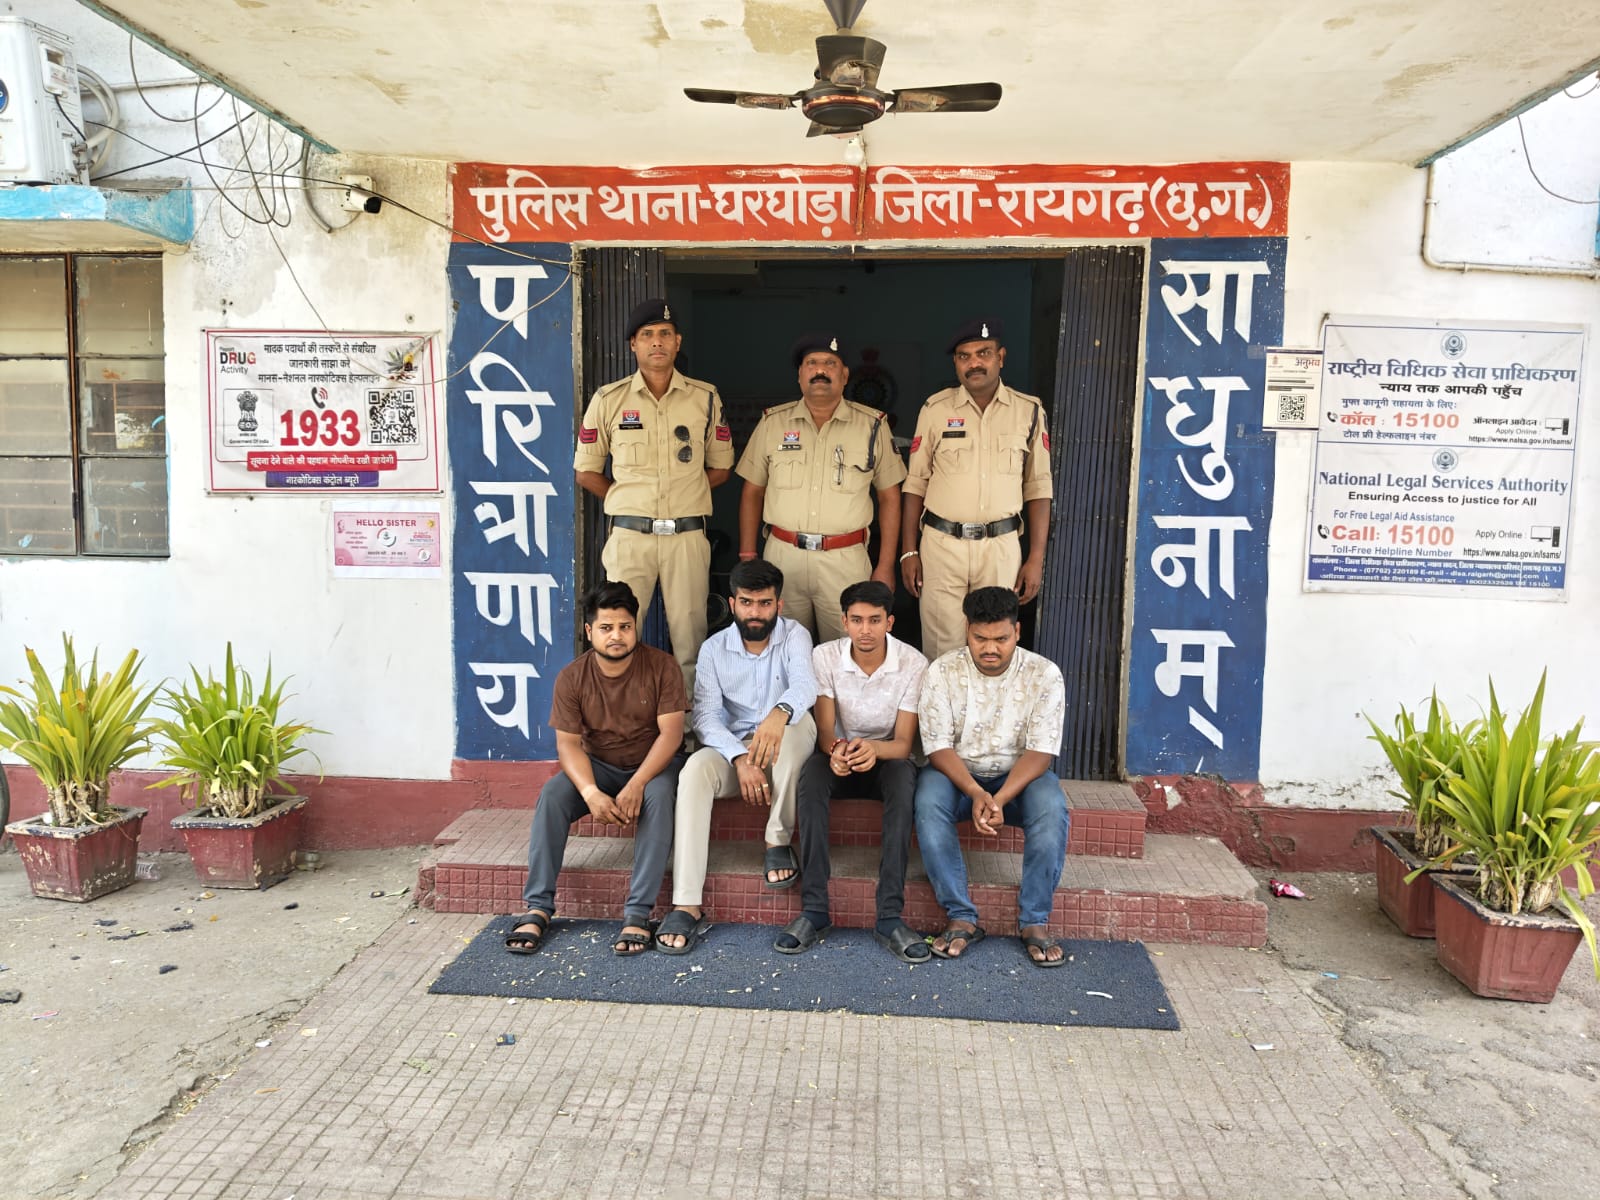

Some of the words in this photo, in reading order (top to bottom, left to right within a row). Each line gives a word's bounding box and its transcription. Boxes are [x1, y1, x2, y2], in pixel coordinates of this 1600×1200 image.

[469, 169, 593, 242] पुलिस
[264, 344, 284, 354] मादक
[307, 342, 317, 354] की
[343, 342, 350, 354] से
[220, 352, 256, 364] DRUG
[289, 358, 319, 370] जानकारी
[320, 359, 338, 370] साझा
[220, 365, 249, 375] Activity
[1327, 358, 1382, 378] राष्ट्रीय
[1387, 359, 1446, 378] विधिक
[1452, 361, 1486, 380] सेवा
[1491, 364, 1576, 382] प्राधिकरण
[308, 372, 348, 384] नारकोटिक्स
[1379, 383, 1412, 394] न्याय
[1416, 384, 1440, 394] तक
[1444, 382, 1487, 396] आपकी
[1492, 384, 1522, 400] पहुँच
[1363, 398, 1389, 409] कानूनी
[1392, 400, 1423, 408] सहायता
[1426, 400, 1435, 408] के
[1340, 411, 1376, 426] कॉल
[1393, 412, 1460, 428] 15100
[1472, 416, 1508, 426] ऑनलाइन
[1510, 417, 1537, 426] आवेदन
[280, 409, 361, 447] 1933
[1496, 427, 1514, 436] Apply
[1343, 429, 1360, 438] टोल
[1362, 429, 1373, 438] फ्री
[1419, 432, 1437, 440] नंबर
[286, 474, 322, 484] नारकोटिक्स
[1319, 472, 1382, 488] National
[1386, 472, 1427, 491] Legal
[1432, 475, 1494, 491] Services
[1498, 476, 1568, 496] Authority
[1348, 491, 1400, 504] Ensuring
[1402, 492, 1444, 504] Access
[1448, 494, 1459, 504] to
[1461, 494, 1500, 506] justice
[1503, 496, 1519, 506] for
[1522, 496, 1537, 507] All
[1334, 510, 1348, 518] For
[1350, 510, 1368, 519] Free
[1370, 510, 1392, 522] Legal
[1394, 512, 1408, 520] Aid
[1410, 512, 1455, 522] Assistance
[1332, 524, 1380, 541] Call:
[1387, 524, 1455, 546] 15100
[1476, 530, 1497, 540] Apply
[1498, 530, 1522, 540] Online
[1332, 544, 1372, 556] Toll-Free
[1374, 545, 1414, 557] Helpline
[1416, 547, 1453, 558] Number
